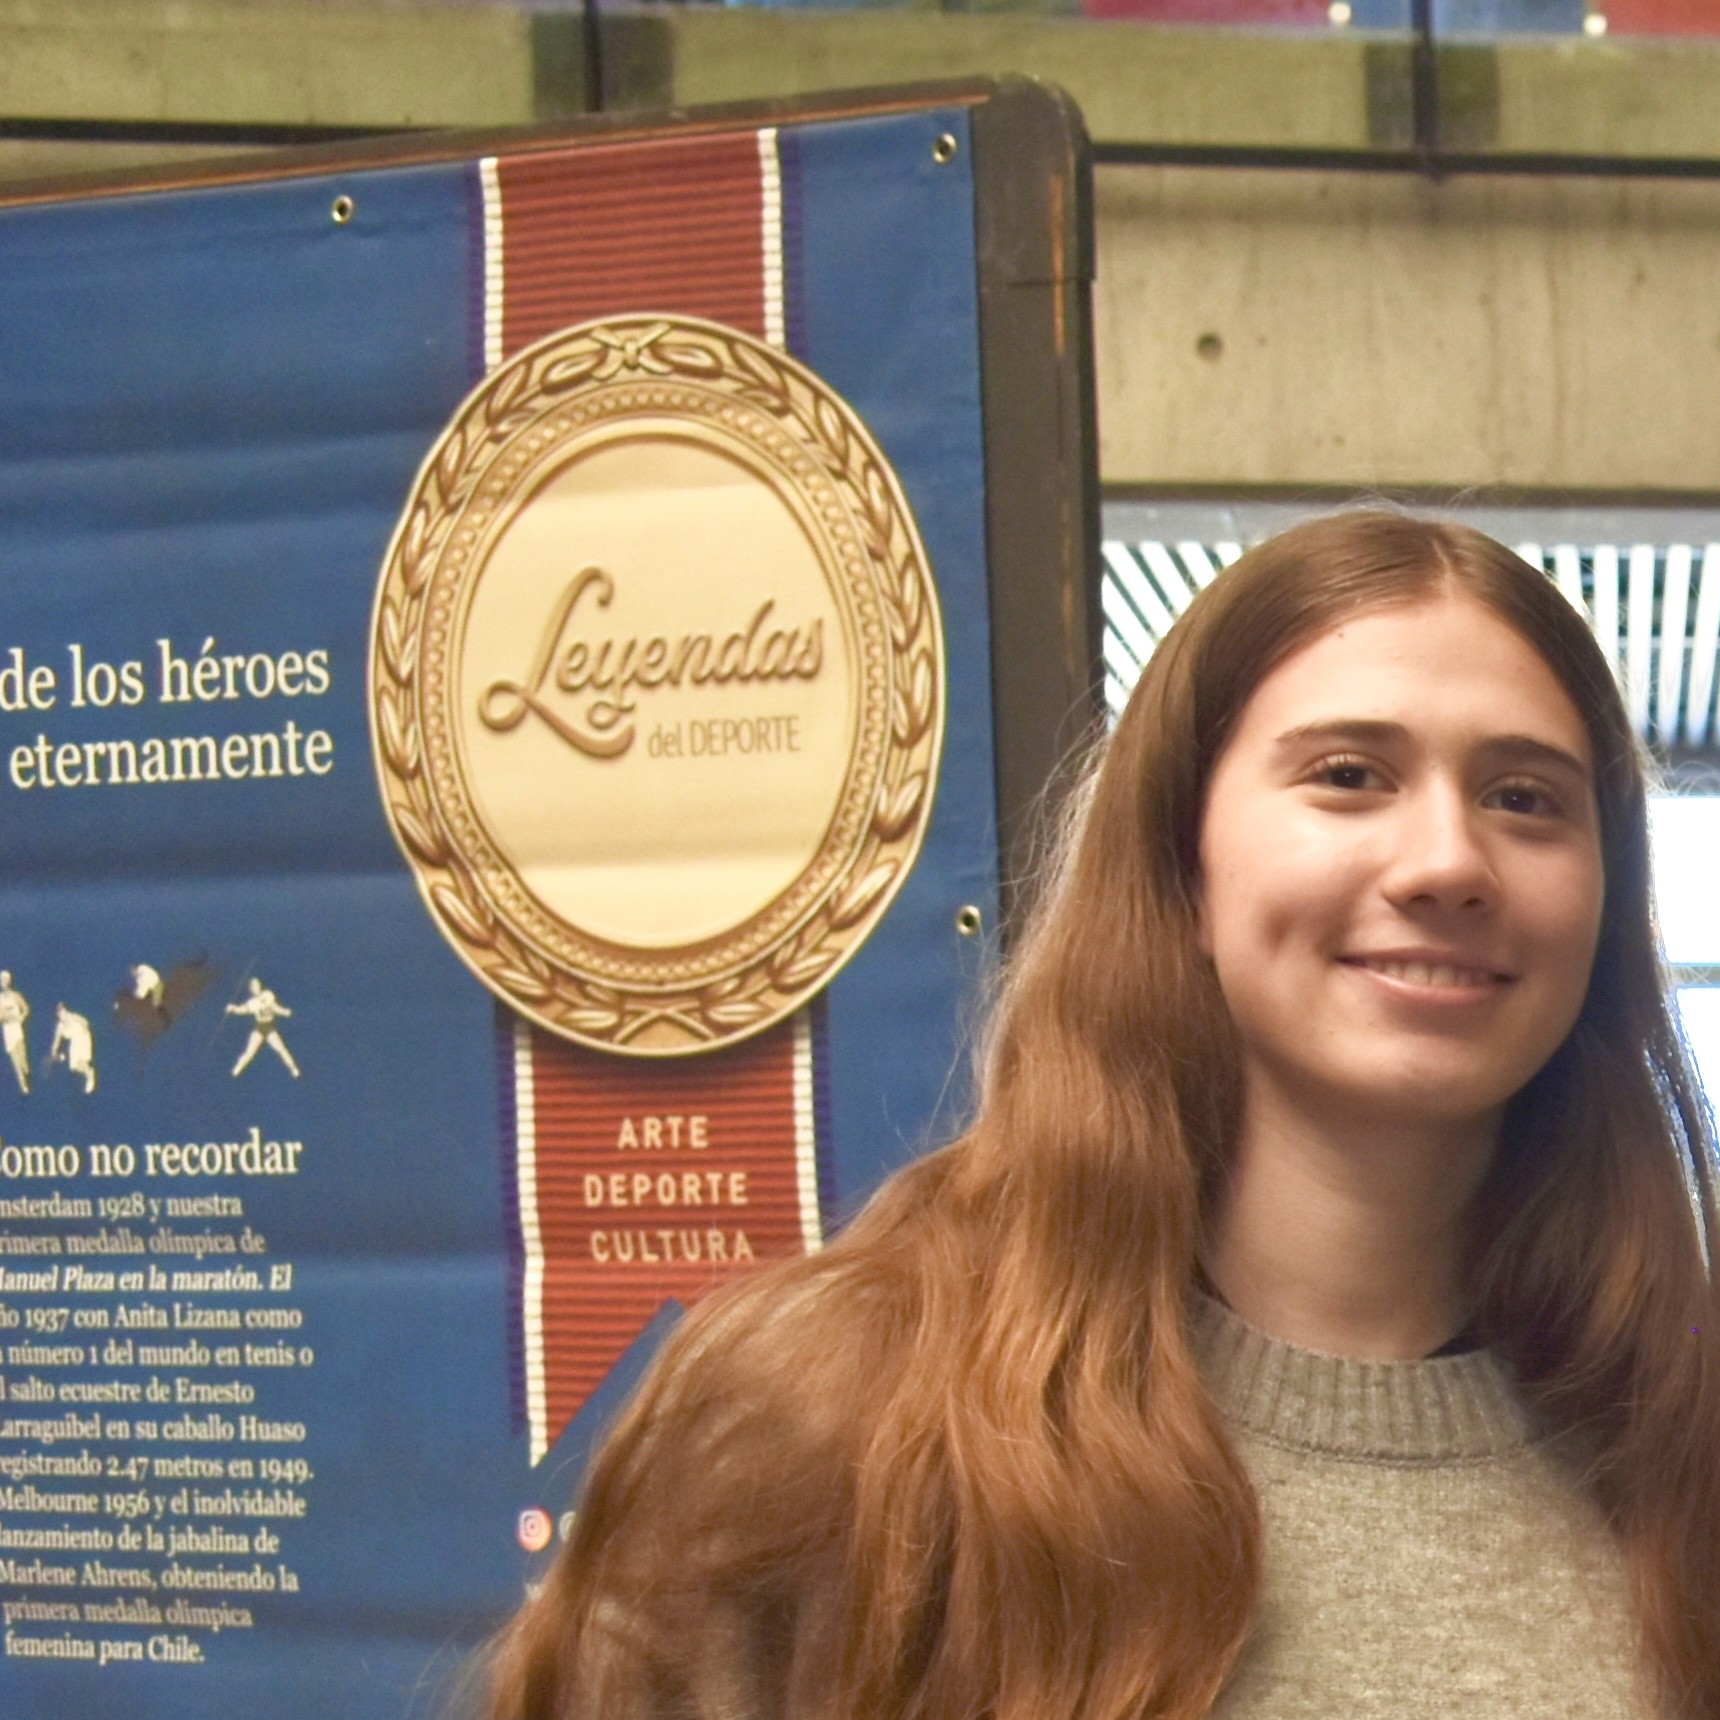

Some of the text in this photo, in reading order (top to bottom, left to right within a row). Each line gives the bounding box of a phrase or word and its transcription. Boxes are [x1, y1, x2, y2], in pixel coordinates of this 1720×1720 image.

[0, 636, 330, 711] de los héroes
[477, 567, 824, 761] Leyendas
[649, 714, 802, 759] del DEPORTE
[10, 720, 333, 790] eternamente
[617, 1115, 709, 1149] ARTE
[0, 1128, 303, 1177] omo no recordar
[584, 1171, 748, 1207] DEPORTE
[99, 1192, 146, 1221] 1928
[150, 1198, 161, 1223] y
[167, 1195, 243, 1217] nuestra
[590, 1228, 756, 1263] CULTURA
[0, 1266, 59, 1292] anuel
[63, 1266, 116, 1291] Plaza
[118, 1272, 145, 1291] en
[149, 1264, 168, 1291] la
[270, 1264, 292, 1290] El
[26, 1302, 303, 1333] 1937 con Anita Lizana como
[105, 1420, 131, 1440] en
[135, 1420, 159, 1441] su
[162, 1414, 235, 1441] caballo
[240, 1415, 306, 1442] Huaso
[0, 1450, 103, 1480] egistrando
[154, 1456, 225, 1478] metros
[227, 1459, 254, 1479] en
[117, 1524, 143, 1551] de
[147, 1524, 165, 1552] la
[169, 1526, 250, 1556] jabalina
[254, 1527, 280, 1554] de
[161, 1563, 276, 1591] obteniendo
[279, 1565, 300, 1592] la
[6, 1631, 96, 1659] femenina
[99, 1640, 144, 1666] para
